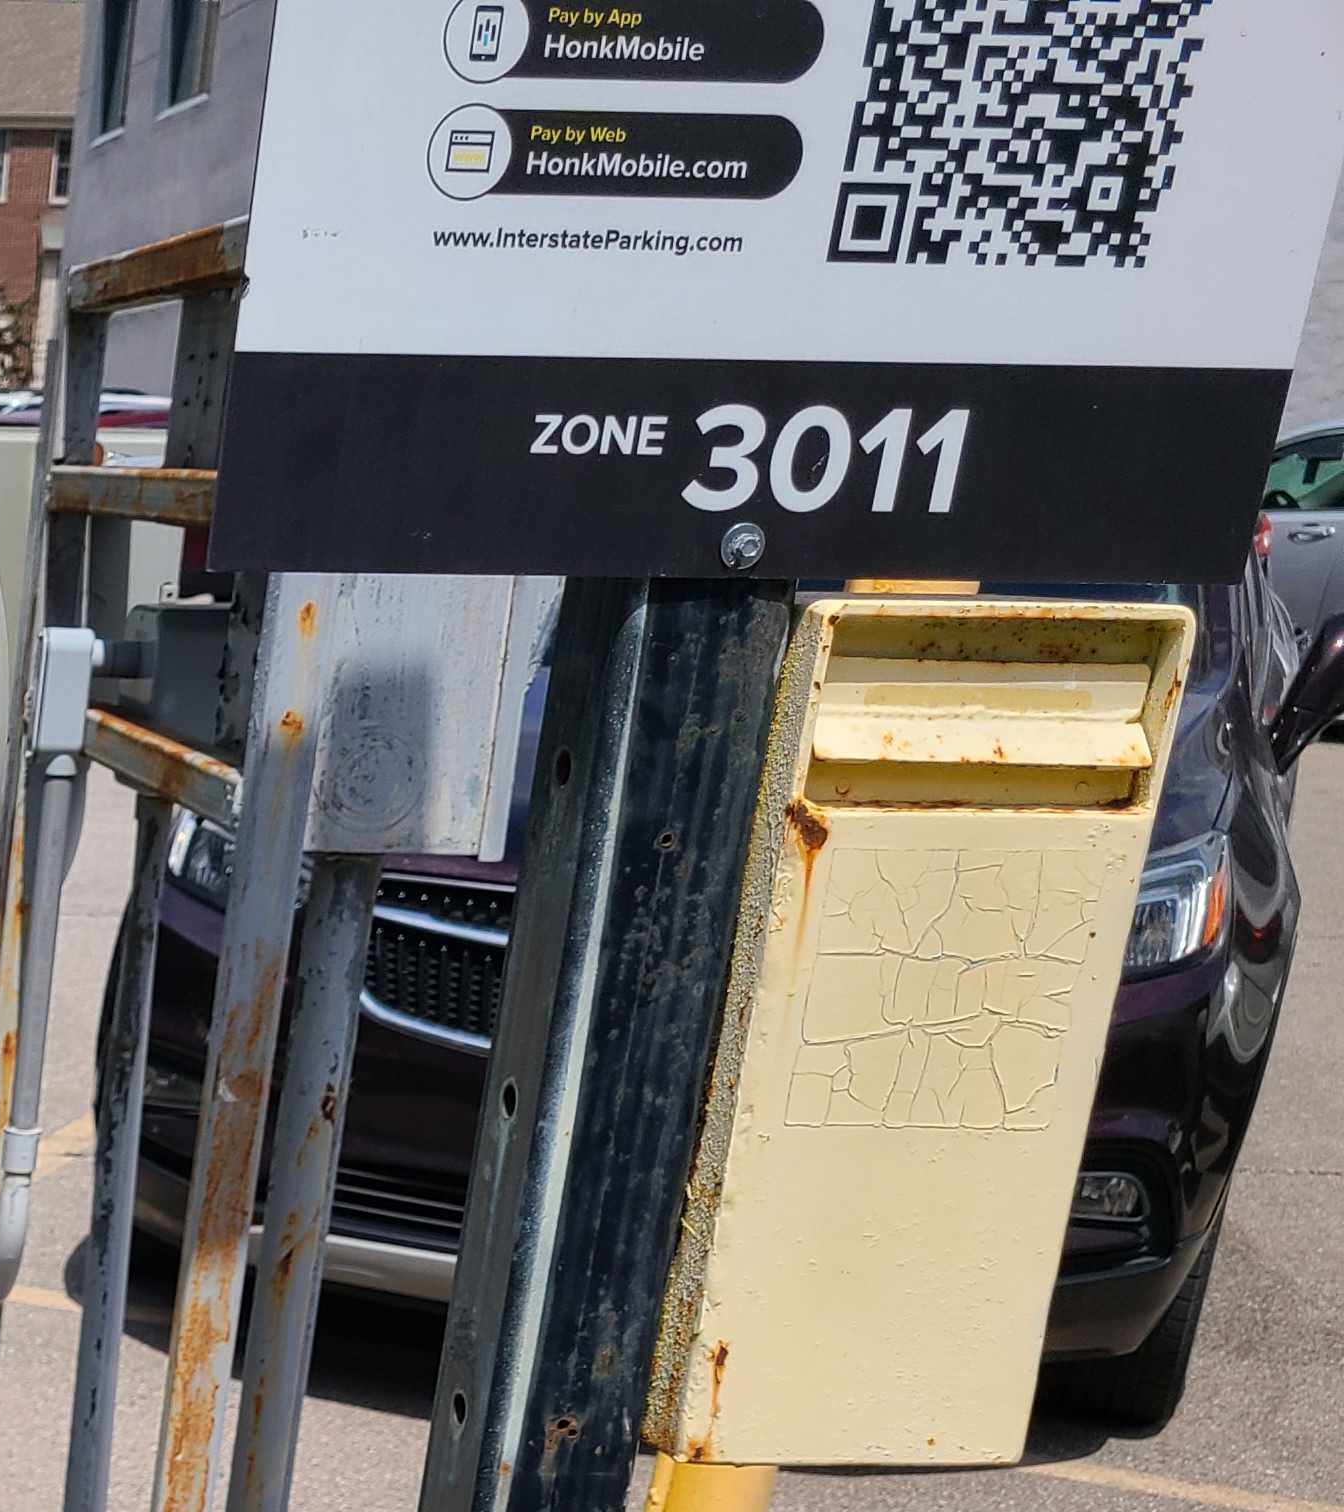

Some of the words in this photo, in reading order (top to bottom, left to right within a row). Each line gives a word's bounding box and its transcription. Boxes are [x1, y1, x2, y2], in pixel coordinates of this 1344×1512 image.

[547, 7, 578, 26] Pay
[583, 8, 605, 27] by
[607, 9, 643, 28] App
[543, 34, 705, 62] HonkMobile
[530, 125, 562, 144] Pay
[565, 126, 586, 145] by
[590, 126, 627, 143] Web
[525, 151, 748, 180] HonkMobile.com
[432, 227, 744, 256] www.InterstateParking.com
[529, 413, 669, 457] ZONE
[680, 404, 971, 514] 3011
